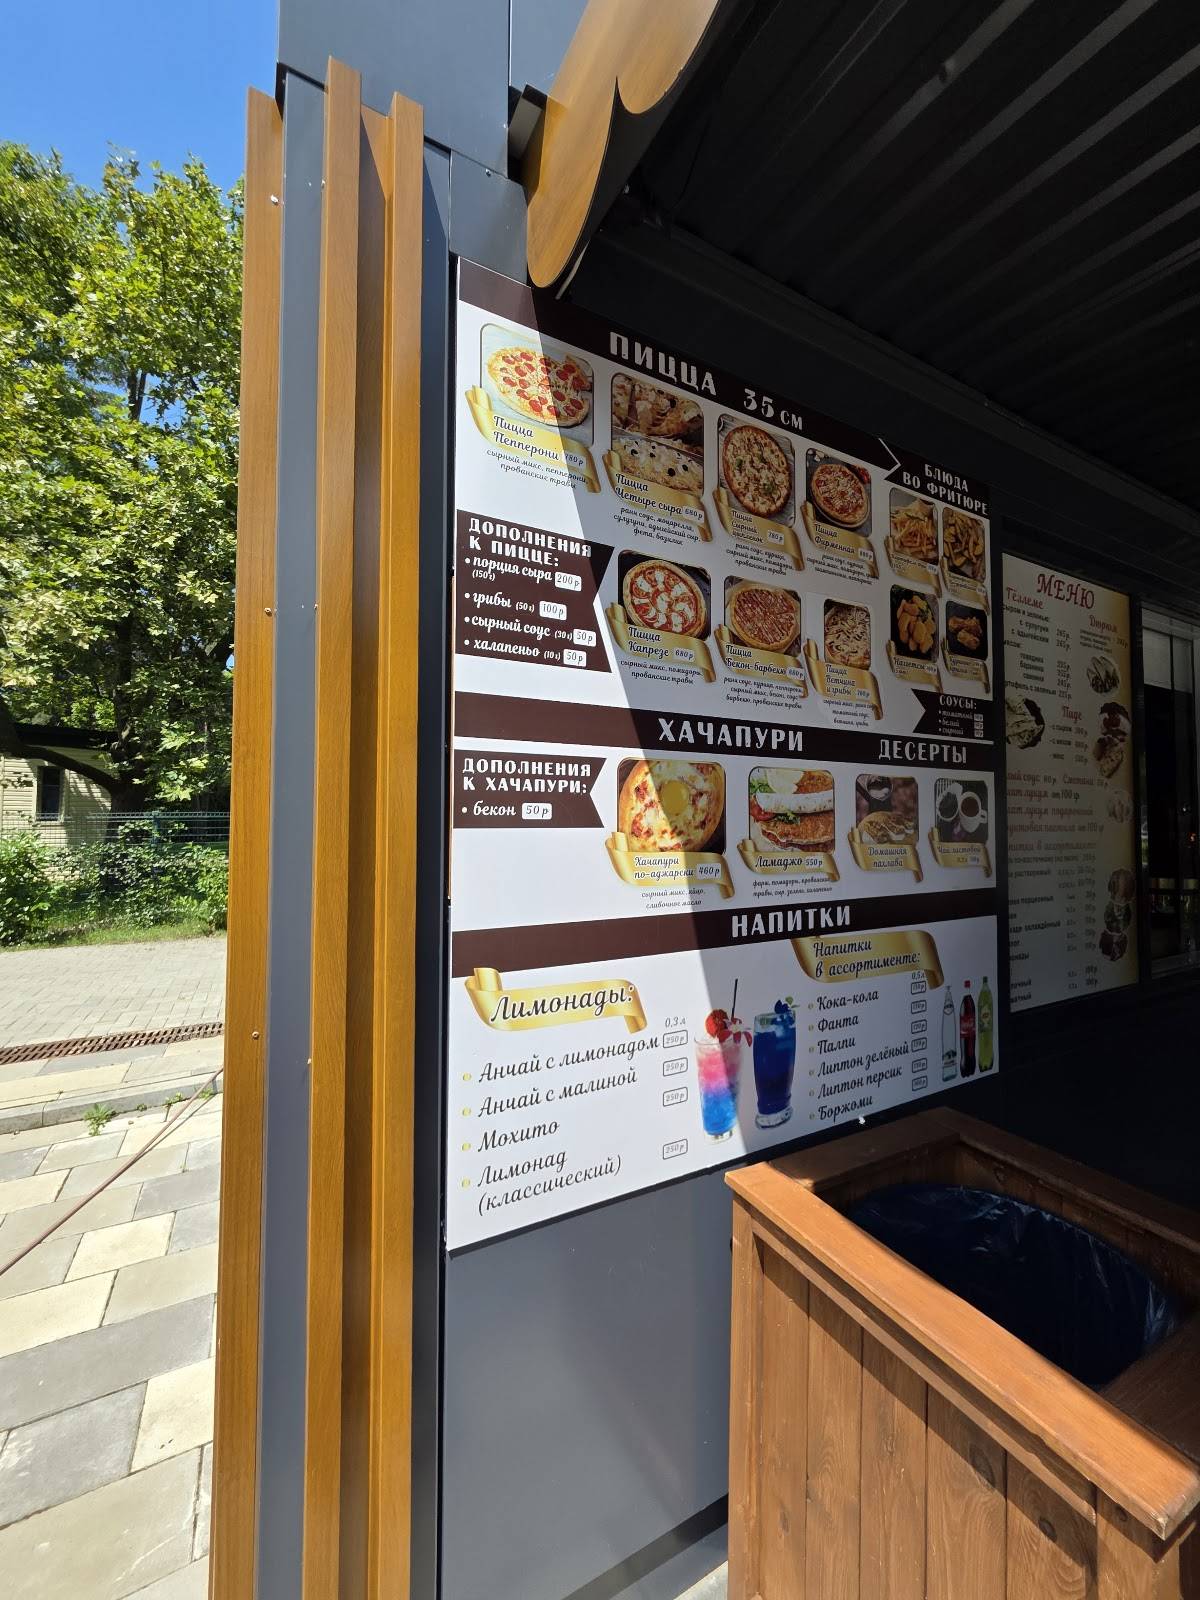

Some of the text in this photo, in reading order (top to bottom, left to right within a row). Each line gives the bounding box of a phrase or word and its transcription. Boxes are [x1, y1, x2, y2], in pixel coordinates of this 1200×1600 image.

[609, 331, 804, 431] ПИЦЦА 35 см
[493, 415, 534, 438] Пицца
[486, 449, 520, 463] сырный
[493, 431, 559, 460] Пепперони
[500, 462, 576, 488] прованские травы
[616, 472, 648, 492] Пицца
[924, 463, 968, 492] БЛЮДА
[616, 487, 656, 509] Четыре
[658, 501, 682, 516] сыра
[902, 471, 988, 516] ВО ФРИТЮРЕ
[732, 510, 752, 522] Пицца
[468, 517, 592, 558] ДОПОЛНЕНИЯ
[814, 522, 838, 538] Пицца
[469, 535, 559, 567] К ПИЦЦЕ:
[472, 556, 520, 575] порция
[522, 565, 553, 584] сыра
[472, 592, 512, 609] грибы
[1036, 573, 1095, 610] МЕНЮ
[471, 615, 522, 633] сырный
[523, 622, 552, 640] соус
[628, 626, 662, 642] Пицца
[473, 638, 540, 657] халапеньо
[628, 640, 670, 660] Капрезе
[726, 644, 752, 658] Пицца
[620, 660, 647, 669] сырный
[632, 670, 670, 682] прованские
[826, 664, 848, 675] Пицца
[658, 718, 804, 752] ХАЧАПУРИ
[878, 739, 967, 764] ДЕСЕРТЫ
[462, 758, 591, 777] ДОПОЛНЕНИЯ
[463, 776, 587, 794] К ХАЧАПУРИ:
[473, 800, 517, 816] бекон
[634, 856, 680, 869] Хачапури
[634, 868, 694, 881] по-аджарски
[756, 856, 802, 871] Ламаджо
[641, 890, 668, 900] сырный
[732, 906, 850, 938] НАПИТКИ
[813, 939, 872, 958] Напитки
[816, 952, 921, 978] в ассортименте:
[490, 985, 634, 1022] Лимонады:
[816, 989, 880, 1011] Кока-кола
[817, 1014, 860, 1033] Фанта
[817, 1036, 856, 1055] Палпи
[478, 1054, 542, 1083] Анчай
[546, 1056, 554, 1069] с
[559, 1036, 660, 1067] лимонадом
[817, 1040, 910, 1078] Липтон зелёный
[478, 1087, 542, 1118] Анчай
[546, 1088, 554, 1102] с
[559, 1067, 638, 1100] малиной
[817, 1080, 864, 1100] Липтон
[865, 1068, 903, 1089] персик
[818, 1095, 874, 1122] Боржоми
[478, 1120, 560, 1152] Мохито
[477, 1150, 568, 1188] Лимонад
[478, 1155, 622, 1216] (классический)
